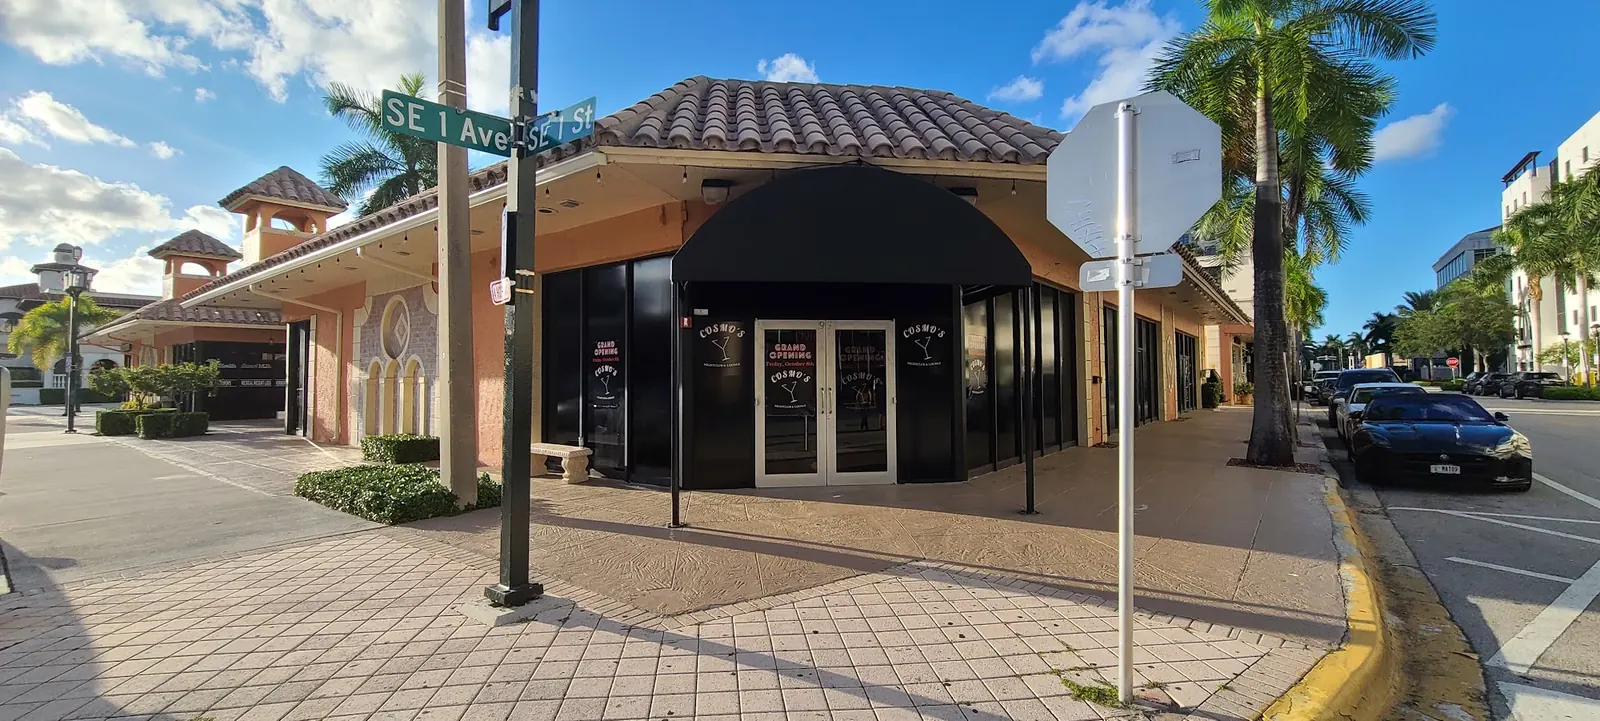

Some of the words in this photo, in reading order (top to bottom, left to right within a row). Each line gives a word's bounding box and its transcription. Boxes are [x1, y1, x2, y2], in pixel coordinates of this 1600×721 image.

[386, 98, 425, 133] SE
[438, 110, 447, 138] 1
[460, 117, 508, 150] Ave
[528, 121, 552, 151] SE
[558, 115, 564, 140] 1
[572, 104, 594, 134] St
[700, 323, 745, 338] COSMO'S
[903, 324, 946, 338] COSMO'S
[597, 340, 615, 348] GRAND
[594, 348, 618, 356] OPENING
[594, 364, 618, 377] COSMO'S
[770, 369, 811, 383] COSMO'S
